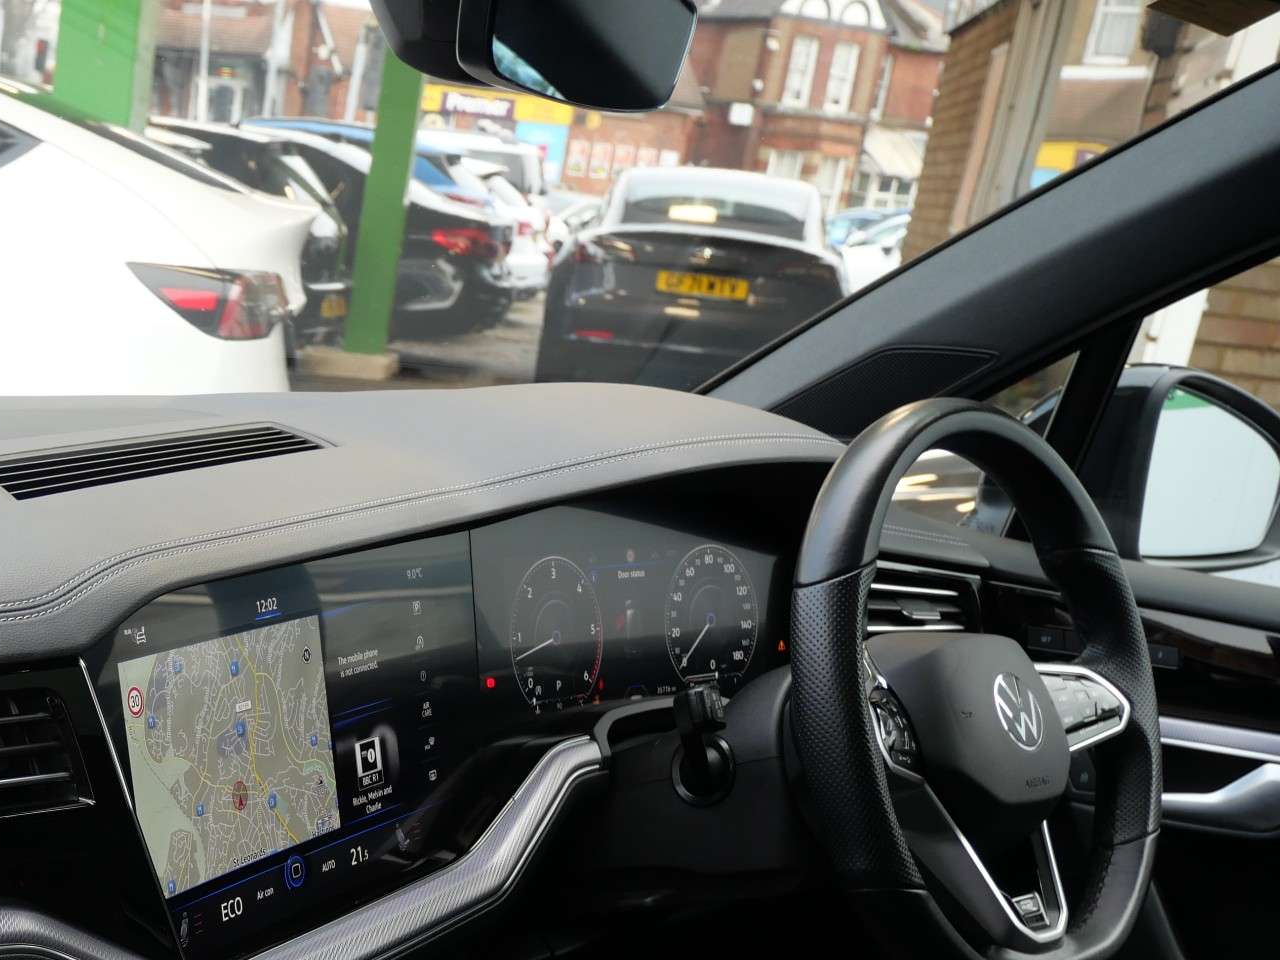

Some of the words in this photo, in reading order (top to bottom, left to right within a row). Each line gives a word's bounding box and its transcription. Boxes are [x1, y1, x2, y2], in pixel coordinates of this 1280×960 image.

[705, 554, 714, 564] 80
[685, 567, 695, 577] 60
[723, 564, 735, 573] 100
[551, 569, 556, 579] 3
[528, 587, 533, 598] 2
[577, 584, 582, 593] 4
[736, 586, 747, 595] 120
[256, 598, 278, 614] 12:02
[671, 628, 680, 637] 20
[338, 656, 347, 666] The
[347, 652, 363, 664] mobile
[363, 649, 379, 660] phone
[710, 659, 716, 669] 0
[583, 670, 589, 680] 6
[528, 678, 534, 689] 0
[556, 680, 562, 690] P
[130, 694, 140, 708] 30
[422, 708, 433, 718] CARE
[362, 775, 372, 786] BBC
[372, 773, 379, 782] R1
[368, 789, 384, 801] Melvin
[384, 785, 393, 795] and
[366, 802, 382, 814] Charlie
[240, 848, 267, 864] Leonards
[350, 846, 369, 866] 21.5
[322, 859, 336, 872] AUTO
[265, 887, 274, 897] con
[221, 896, 243, 922] ECO
